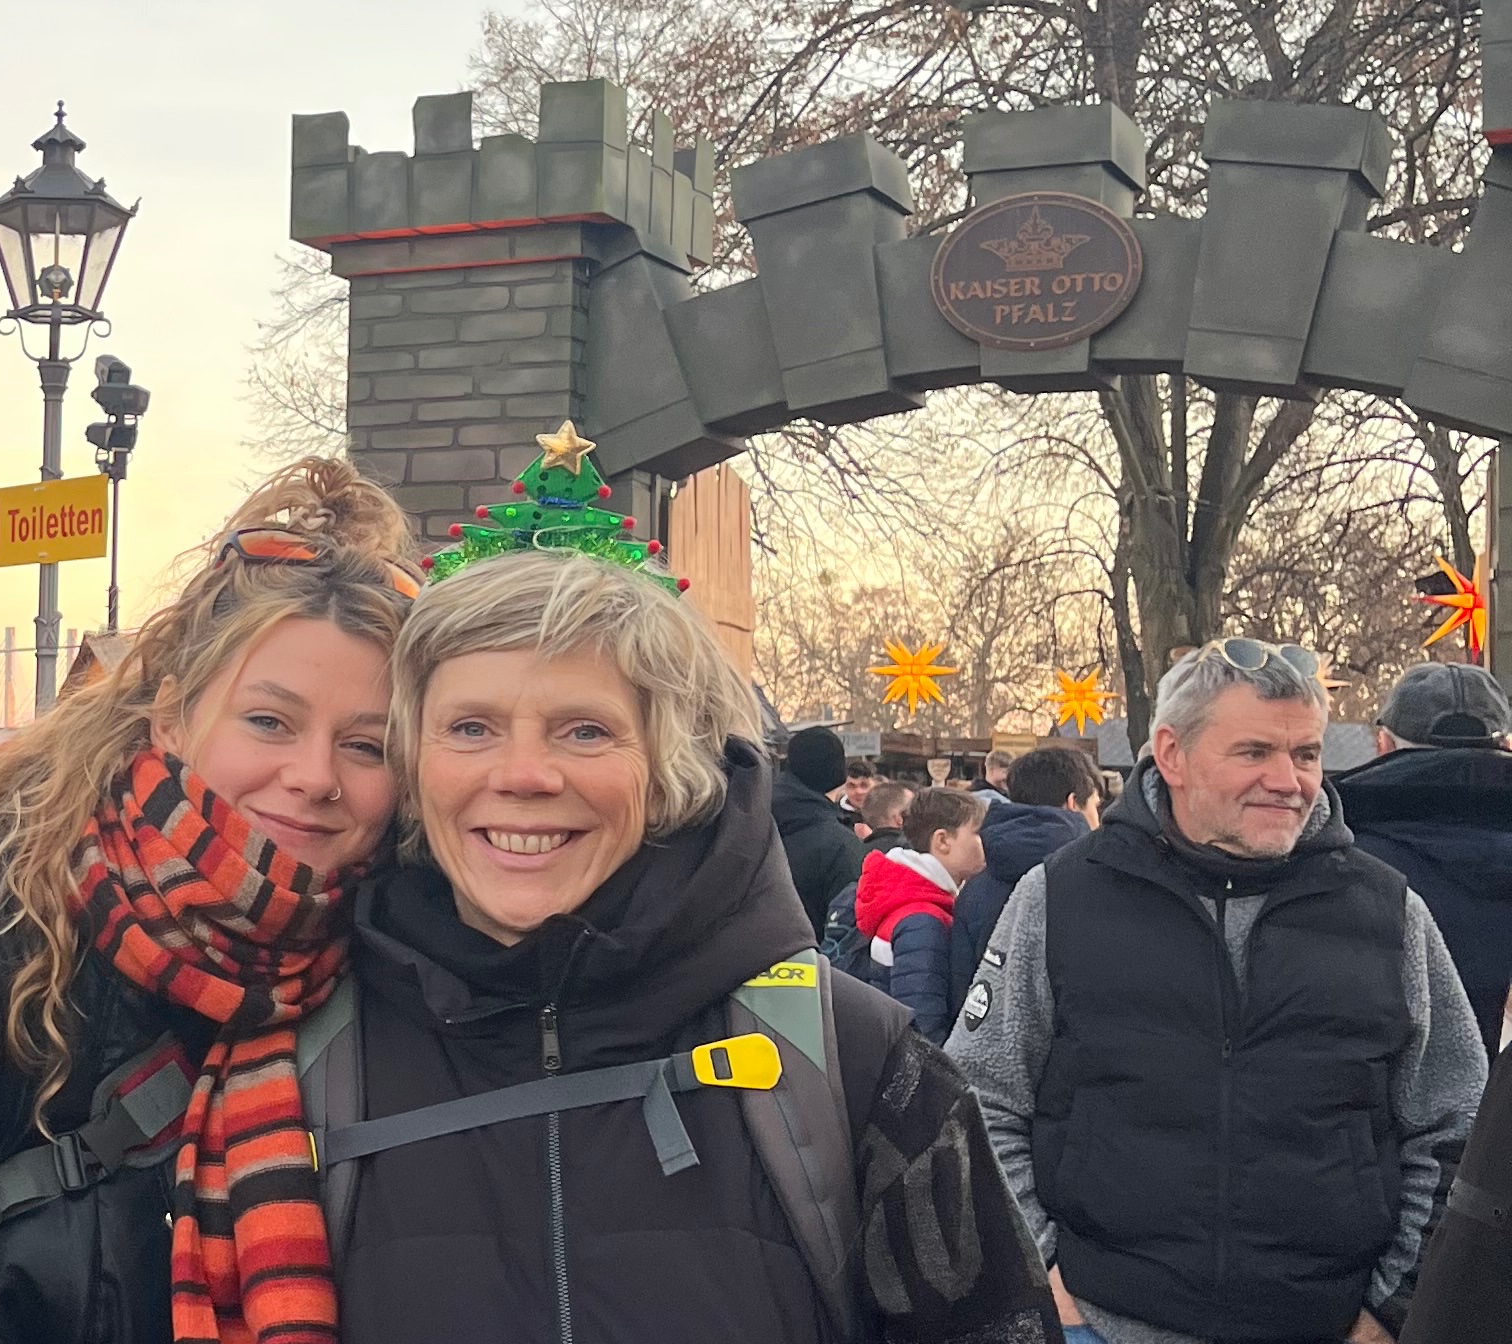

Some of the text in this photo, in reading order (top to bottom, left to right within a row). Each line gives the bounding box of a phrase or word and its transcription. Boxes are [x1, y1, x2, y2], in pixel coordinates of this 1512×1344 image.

[949, 272, 1125, 301] KAISER OTTO
[994, 301, 1077, 325] PFALZ
[7, 503, 104, 543] Toiletten
